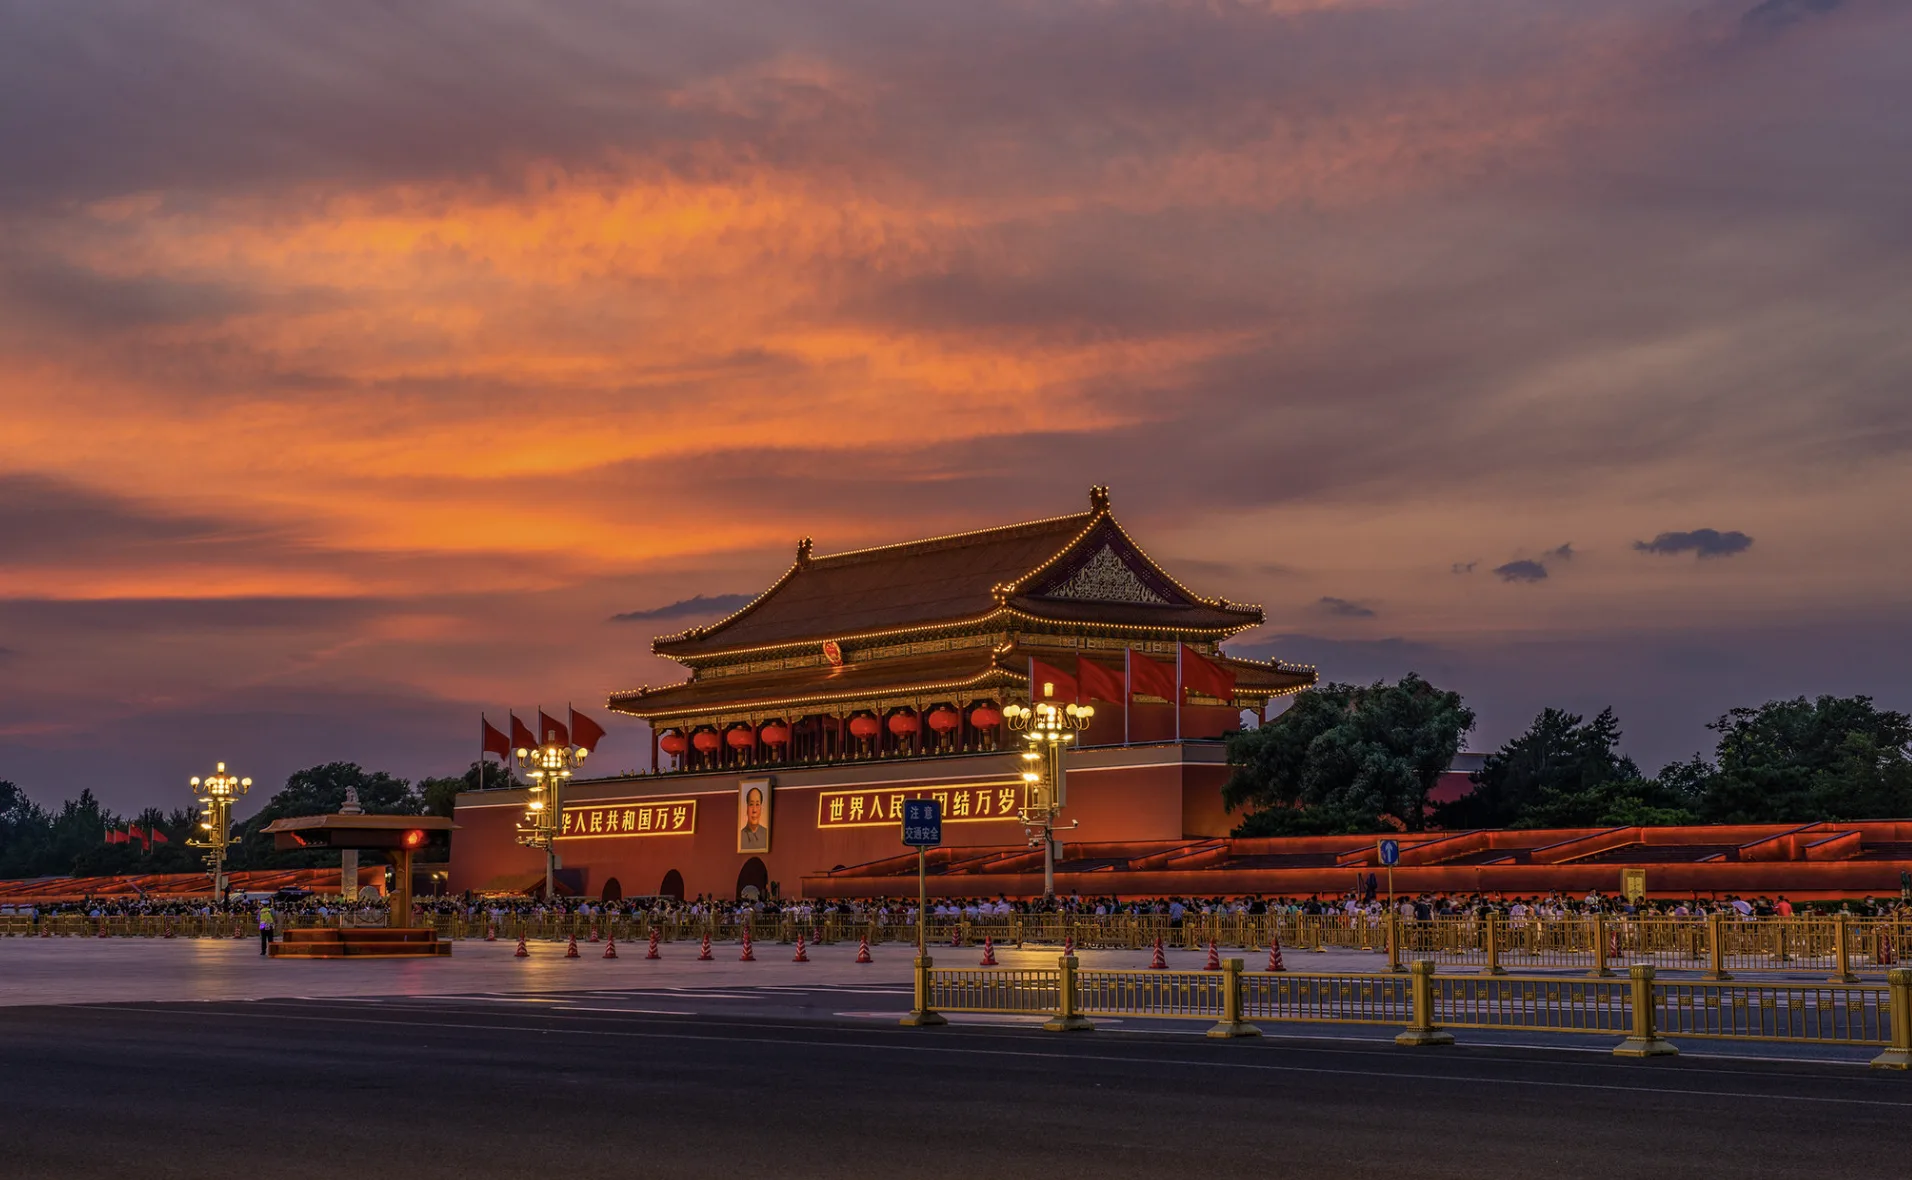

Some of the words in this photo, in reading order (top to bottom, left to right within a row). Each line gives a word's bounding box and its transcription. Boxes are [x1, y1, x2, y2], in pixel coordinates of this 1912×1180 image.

[829, 788, 1015, 822] 世界人民团结万岁
[910, 805, 933, 820] 注意
[561, 806, 687, 835] 华人民共和国万岁
[905, 826, 939, 840] 交通安全
